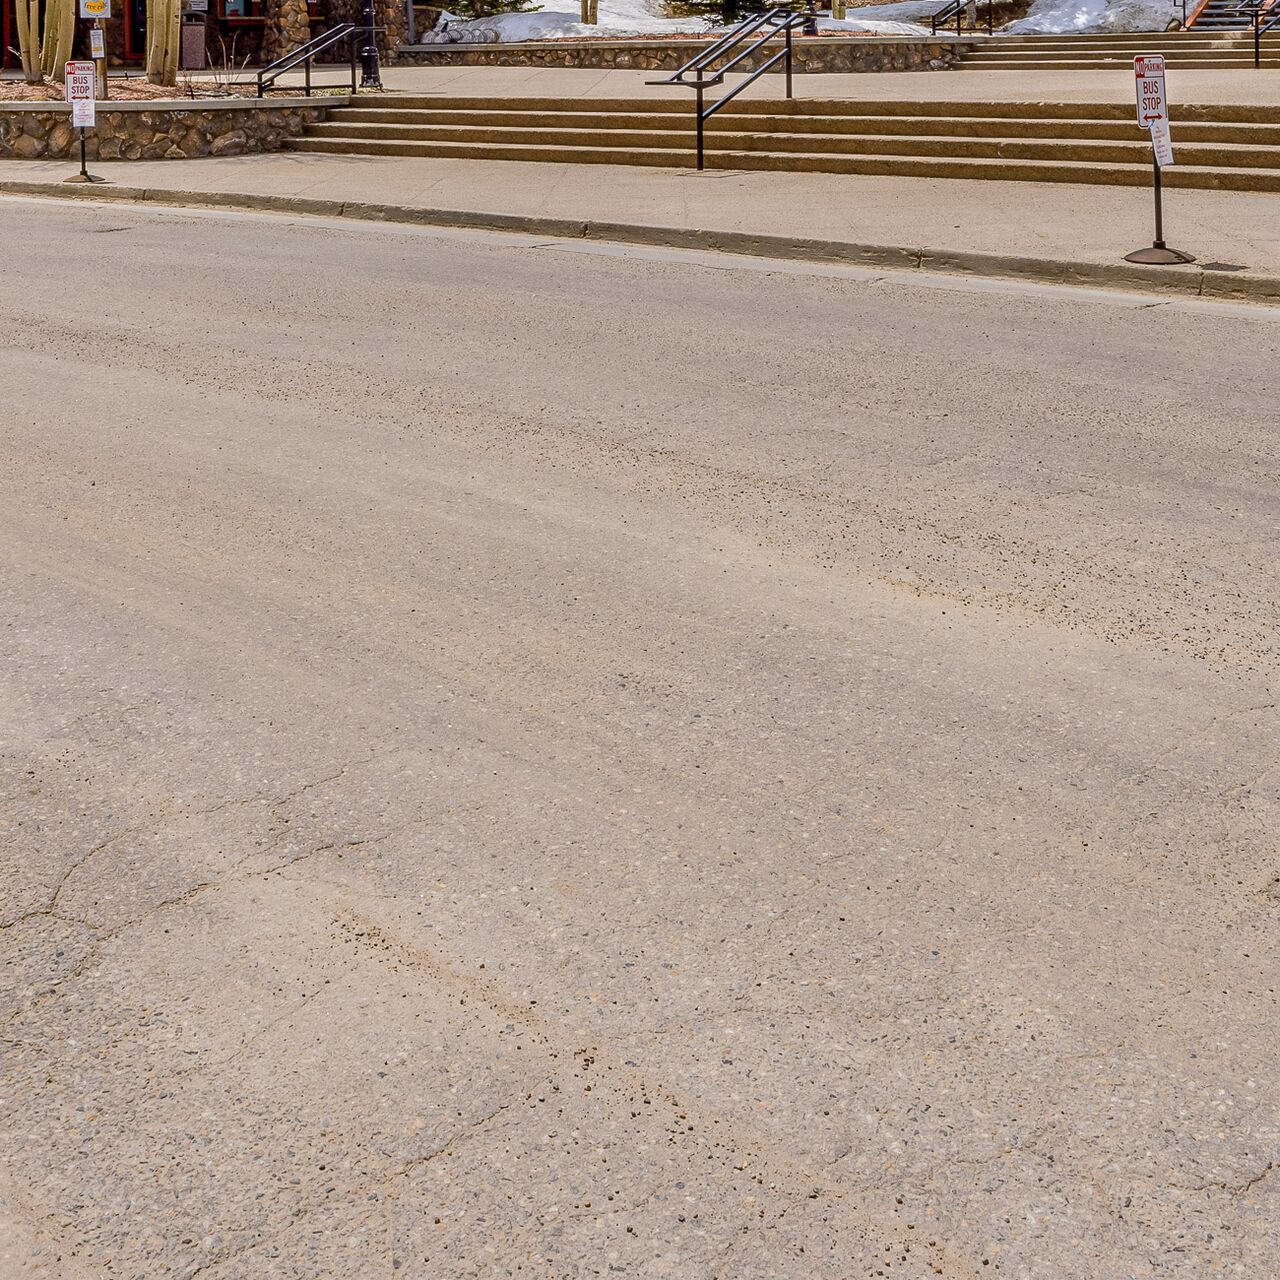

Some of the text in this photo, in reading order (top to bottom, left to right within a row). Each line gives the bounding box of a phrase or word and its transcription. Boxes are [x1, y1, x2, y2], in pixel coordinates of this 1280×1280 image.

[66, 64, 75, 73] NO
[1136, 61, 1163, 74] NO PARKING
[73, 76, 88, 85] BUS
[71, 86, 90, 94] STOP
[1143, 81, 1158, 94] BUS
[1142, 97, 1162, 111] STOP
